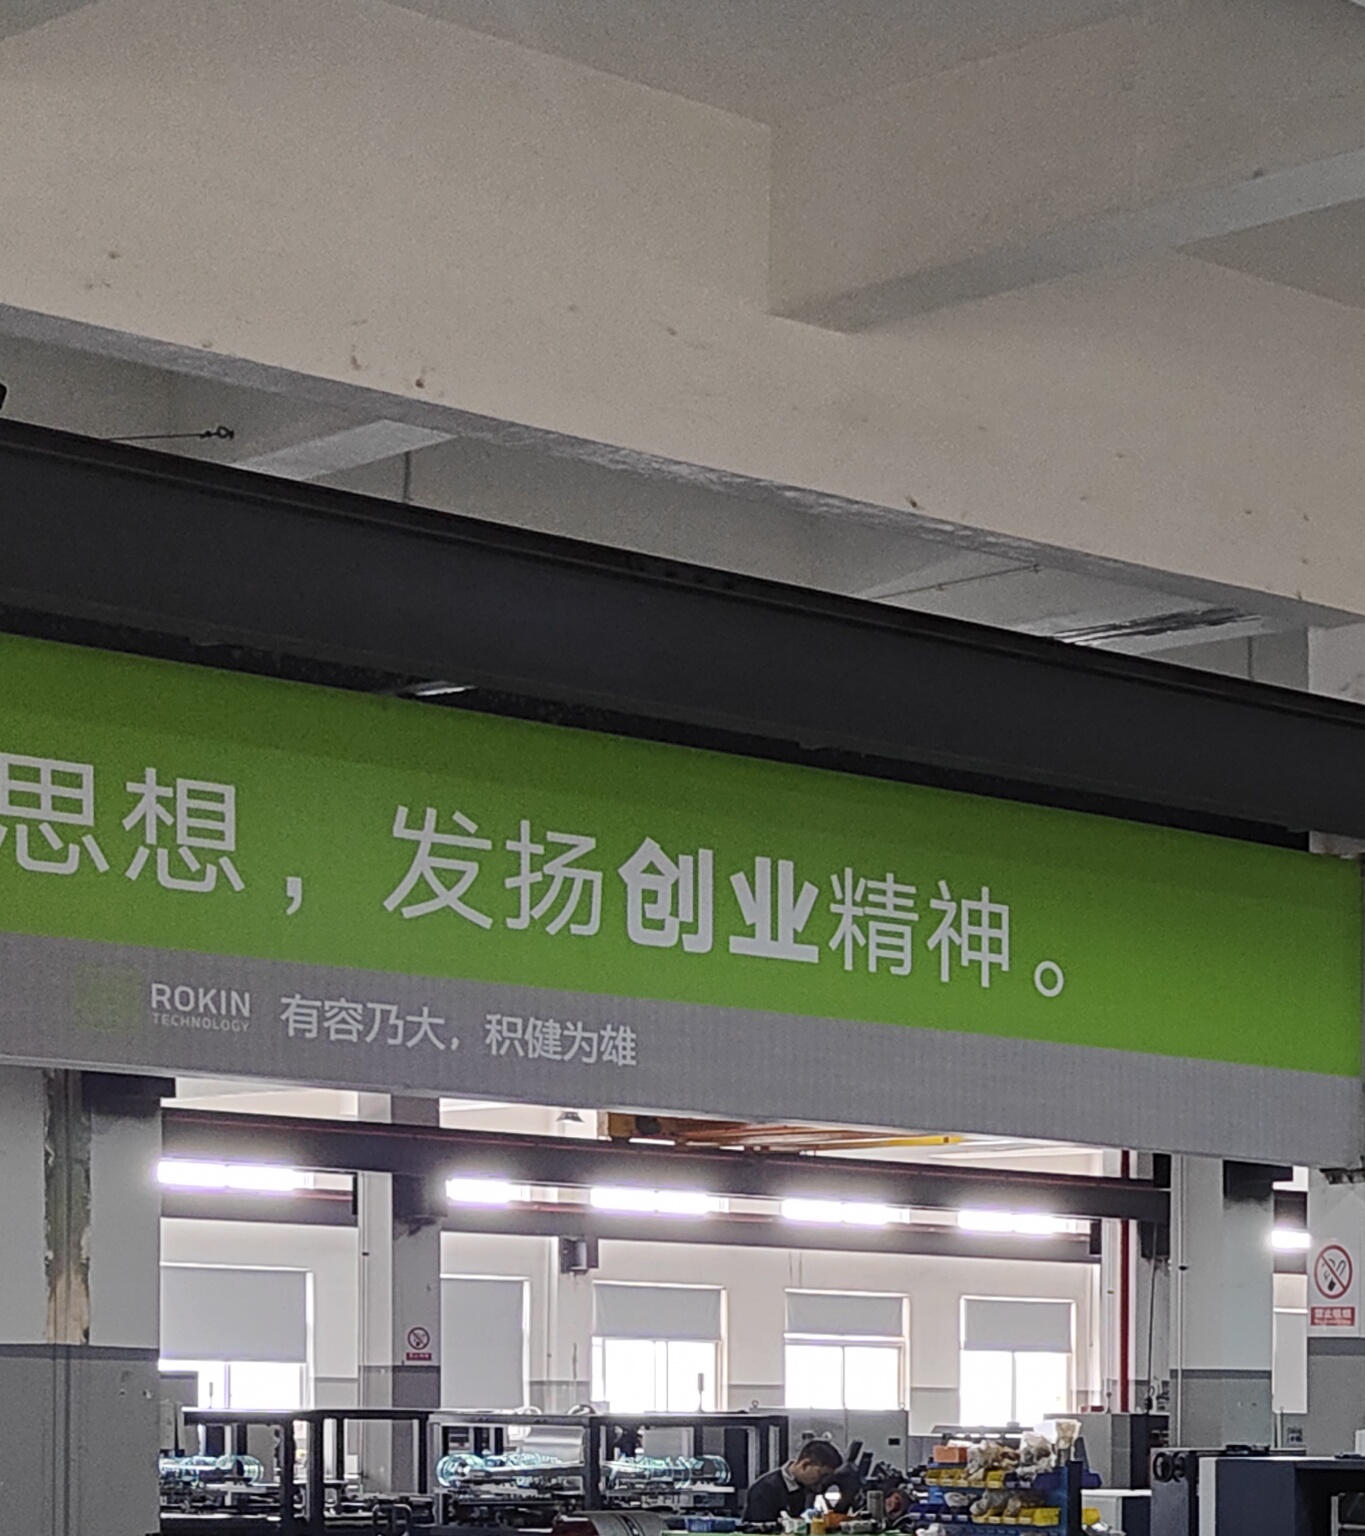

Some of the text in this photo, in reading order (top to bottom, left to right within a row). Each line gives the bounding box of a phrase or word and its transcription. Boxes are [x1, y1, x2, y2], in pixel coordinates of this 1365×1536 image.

[151, 983, 250, 1018] ROKIN
[152, 1012, 250, 1032] TECHNOLOGY
[280, 993, 637, 1067] 有容乃大，积健为雄
